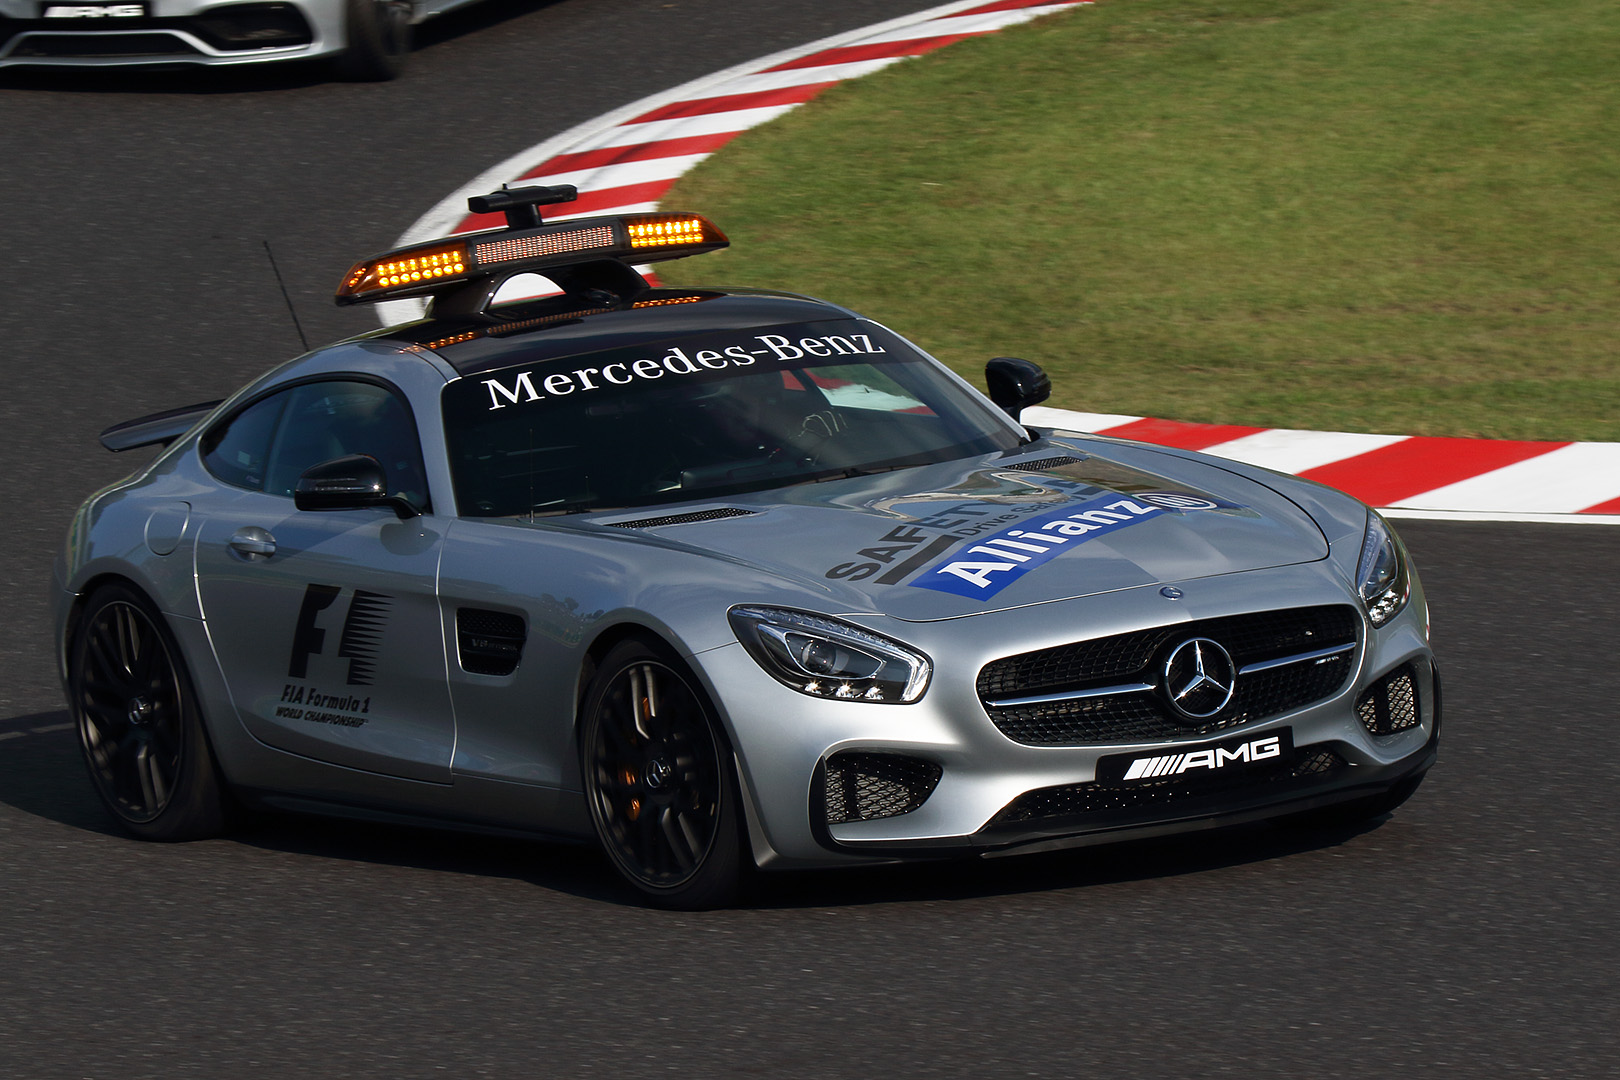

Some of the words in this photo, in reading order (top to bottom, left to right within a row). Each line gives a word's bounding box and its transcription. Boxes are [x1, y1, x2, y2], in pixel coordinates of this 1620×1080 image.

[73, 4, 145, 18] AMG
[480, 333, 887, 410] Mercedes-Benz
[952, 513, 1019, 536] Drive
[936, 499, 1164, 589] Allianz
[288, 583, 396, 686] F1
[275, 706, 304, 720] WORLD
[280, 684, 305, 704] FIA
[306, 688, 361, 713] Formula
[361, 697, 371, 714] 1
[1175, 736, 1281, 775] AMG
